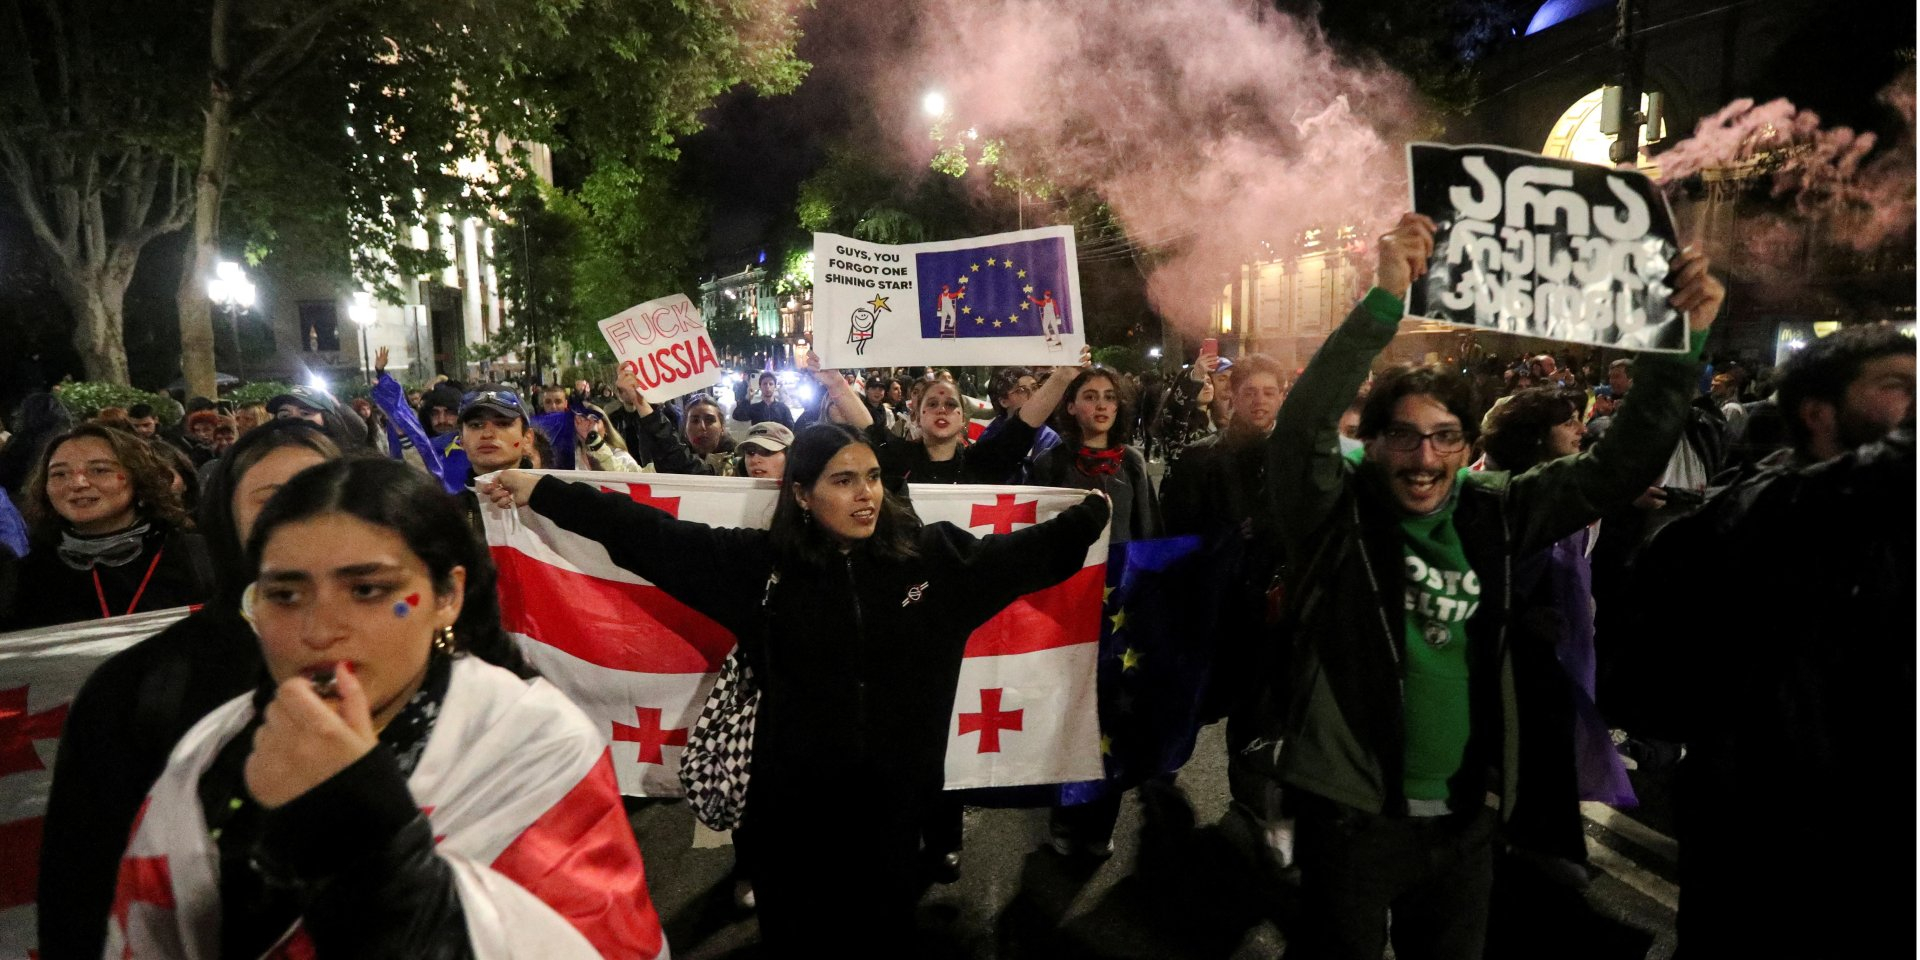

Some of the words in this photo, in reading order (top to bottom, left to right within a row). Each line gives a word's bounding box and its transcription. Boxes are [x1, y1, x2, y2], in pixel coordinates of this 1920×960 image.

[1448, 155, 1650, 242] არა
[836, 245, 871, 261] GUYS,
[874, 252, 900, 263] YOU
[828, 258, 879, 275] FORGOT
[881, 267, 908, 276] ONE
[824, 273, 876, 288] SHINING
[878, 280, 912, 290] STAR!
[606, 301, 703, 355] FUCK
